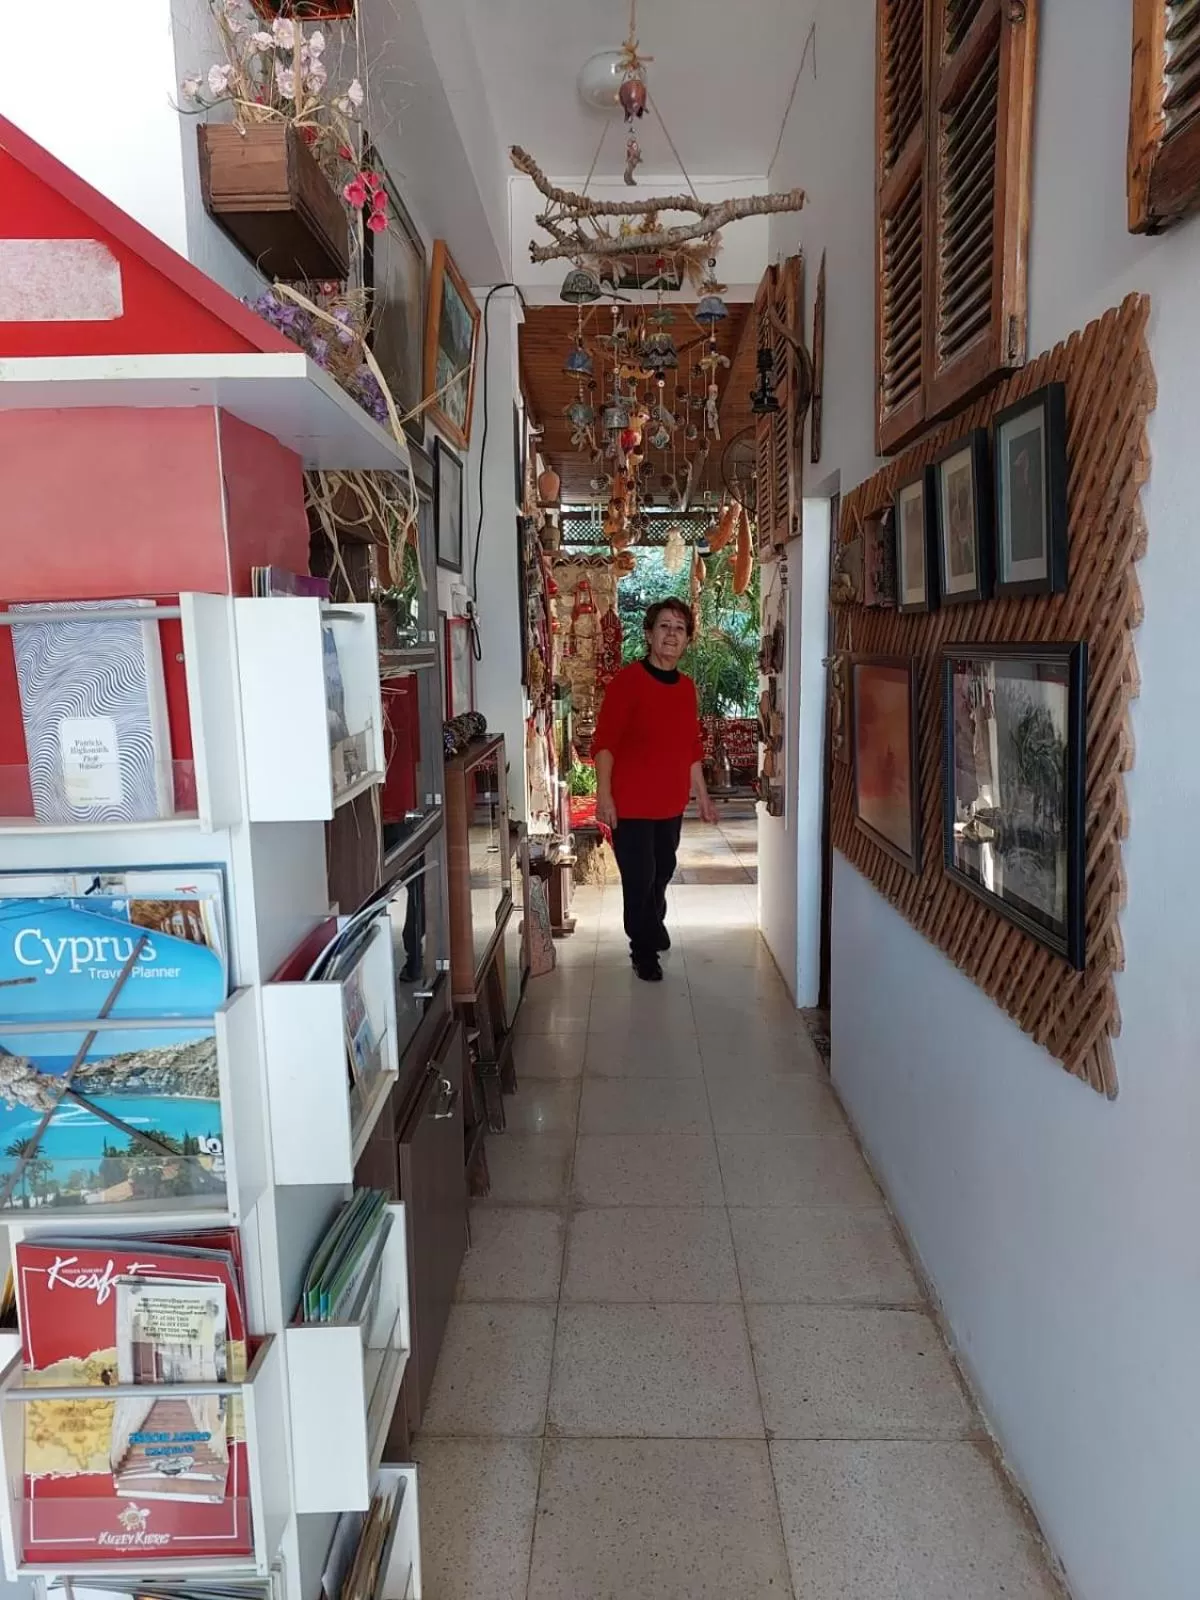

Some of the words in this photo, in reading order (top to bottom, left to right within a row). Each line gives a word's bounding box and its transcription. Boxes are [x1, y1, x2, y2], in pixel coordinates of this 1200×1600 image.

[14, 928, 157, 975] Cyprus
[88, 967, 127, 980] Trav
[131, 965, 181, 978] Planner
[47, 1256, 157, 1305] Kesft
